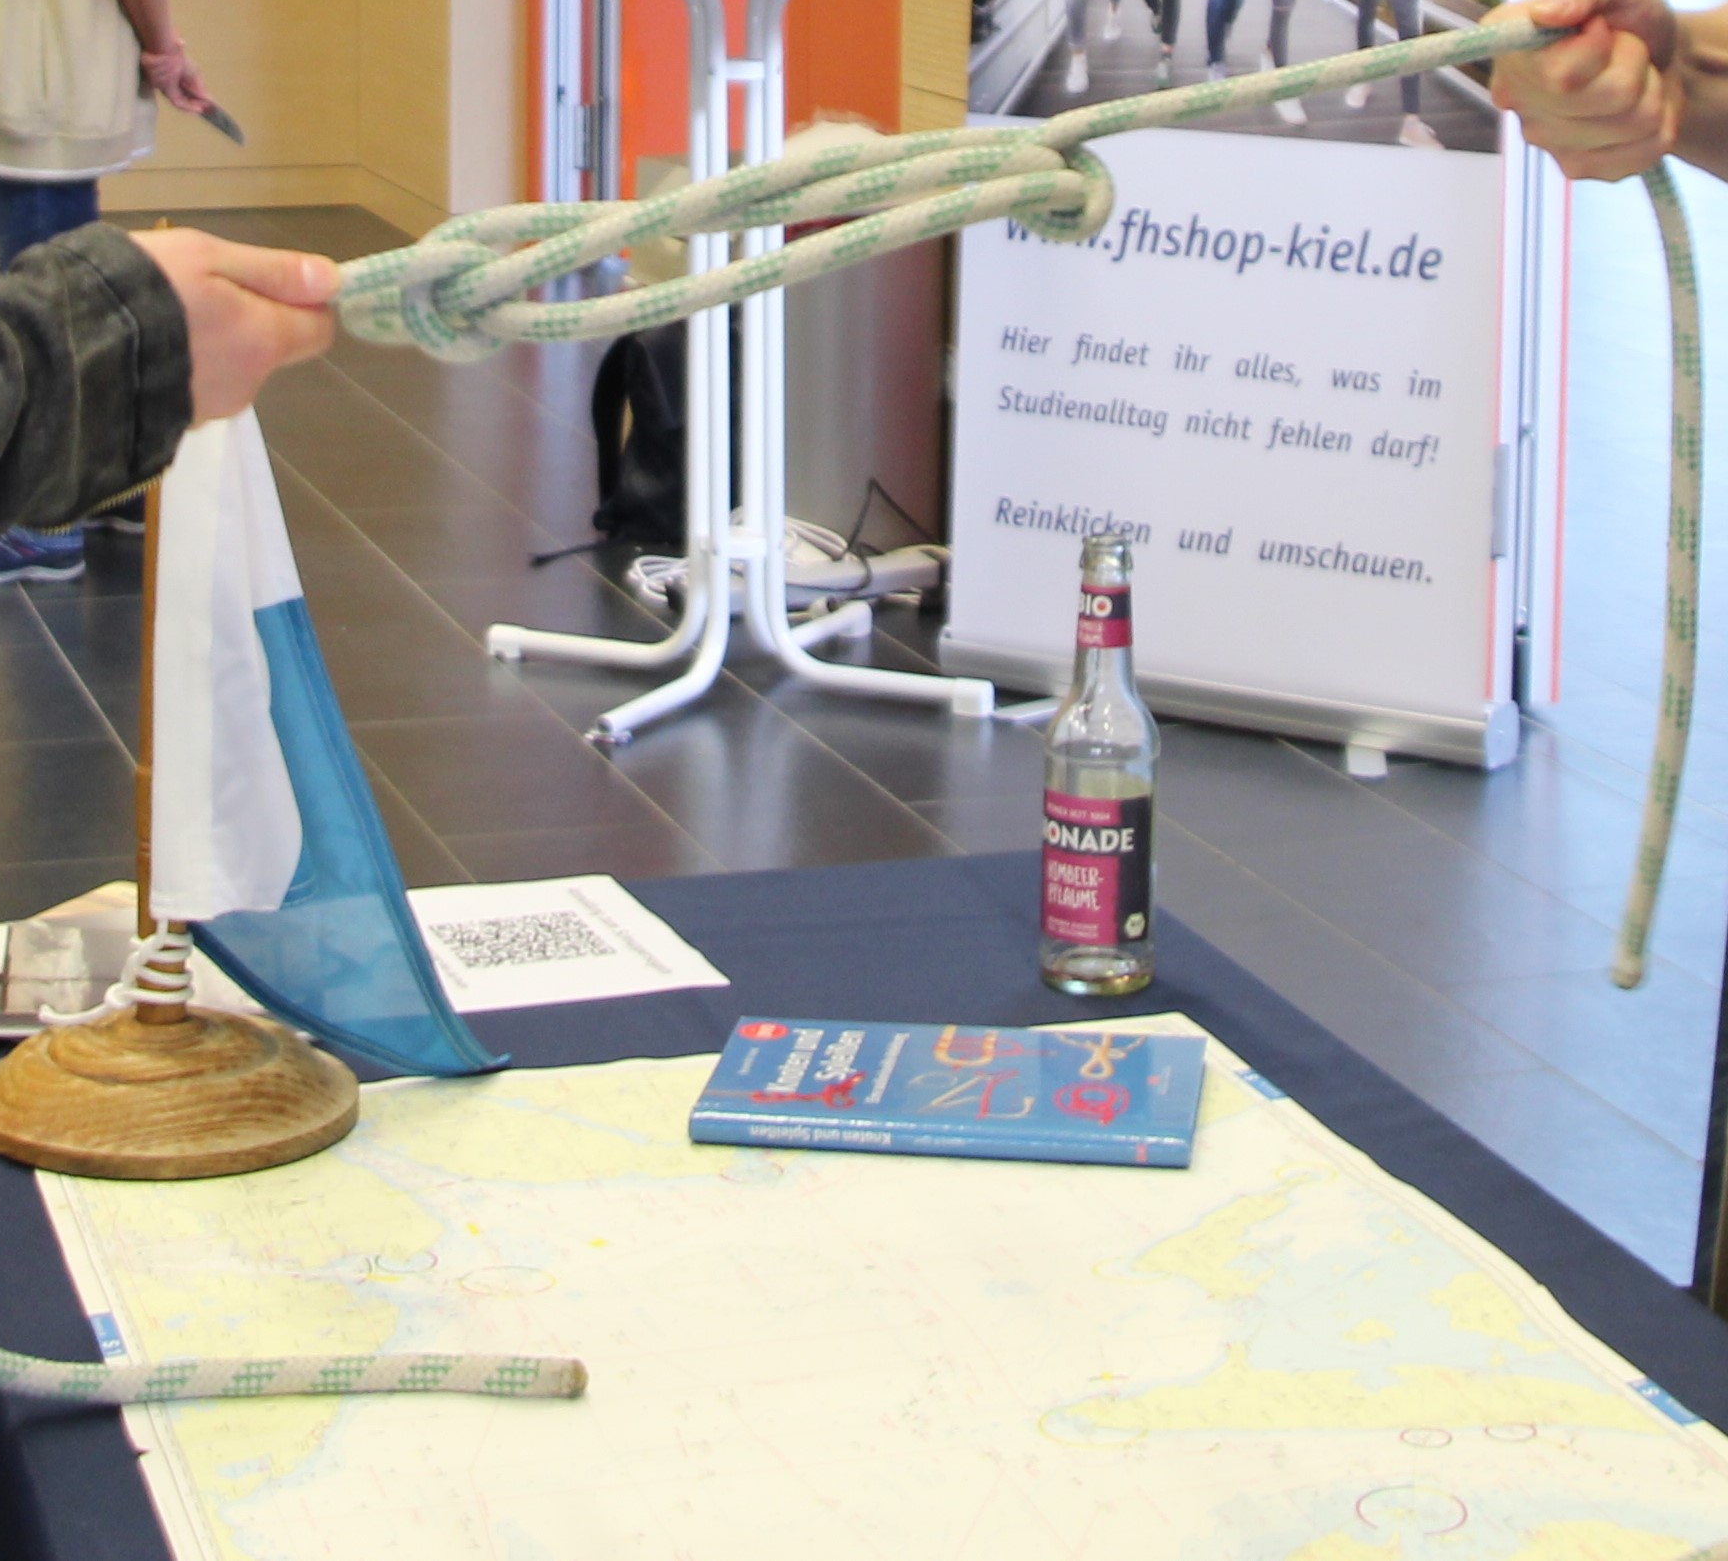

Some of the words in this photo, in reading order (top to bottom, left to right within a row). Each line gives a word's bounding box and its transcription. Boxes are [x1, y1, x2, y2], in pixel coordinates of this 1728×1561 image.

[1000, 326, 1052, 355] Hier
[1072, 333, 1150, 366] findet
[1174, 343, 1212, 373] ihr
[1235, 352, 1303, 387] alles,
[1331, 366, 1381, 393] was
[1408, 369, 1443, 399] im
[998, 385, 1169, 436] Studienalltag
[1185, 409, 1252, 440] nicht
[1266, 417, 1353, 452] fehlen
[1371, 430, 1440, 467] darf!
[995, 496, 1152, 545] Reinklicken
[1178, 527, 1233, 557] und
[1259, 537, 1433, 584] umschauen.
[814, 1128, 841, 1143] und
[843, 1130, 892, 1146] Knoten
